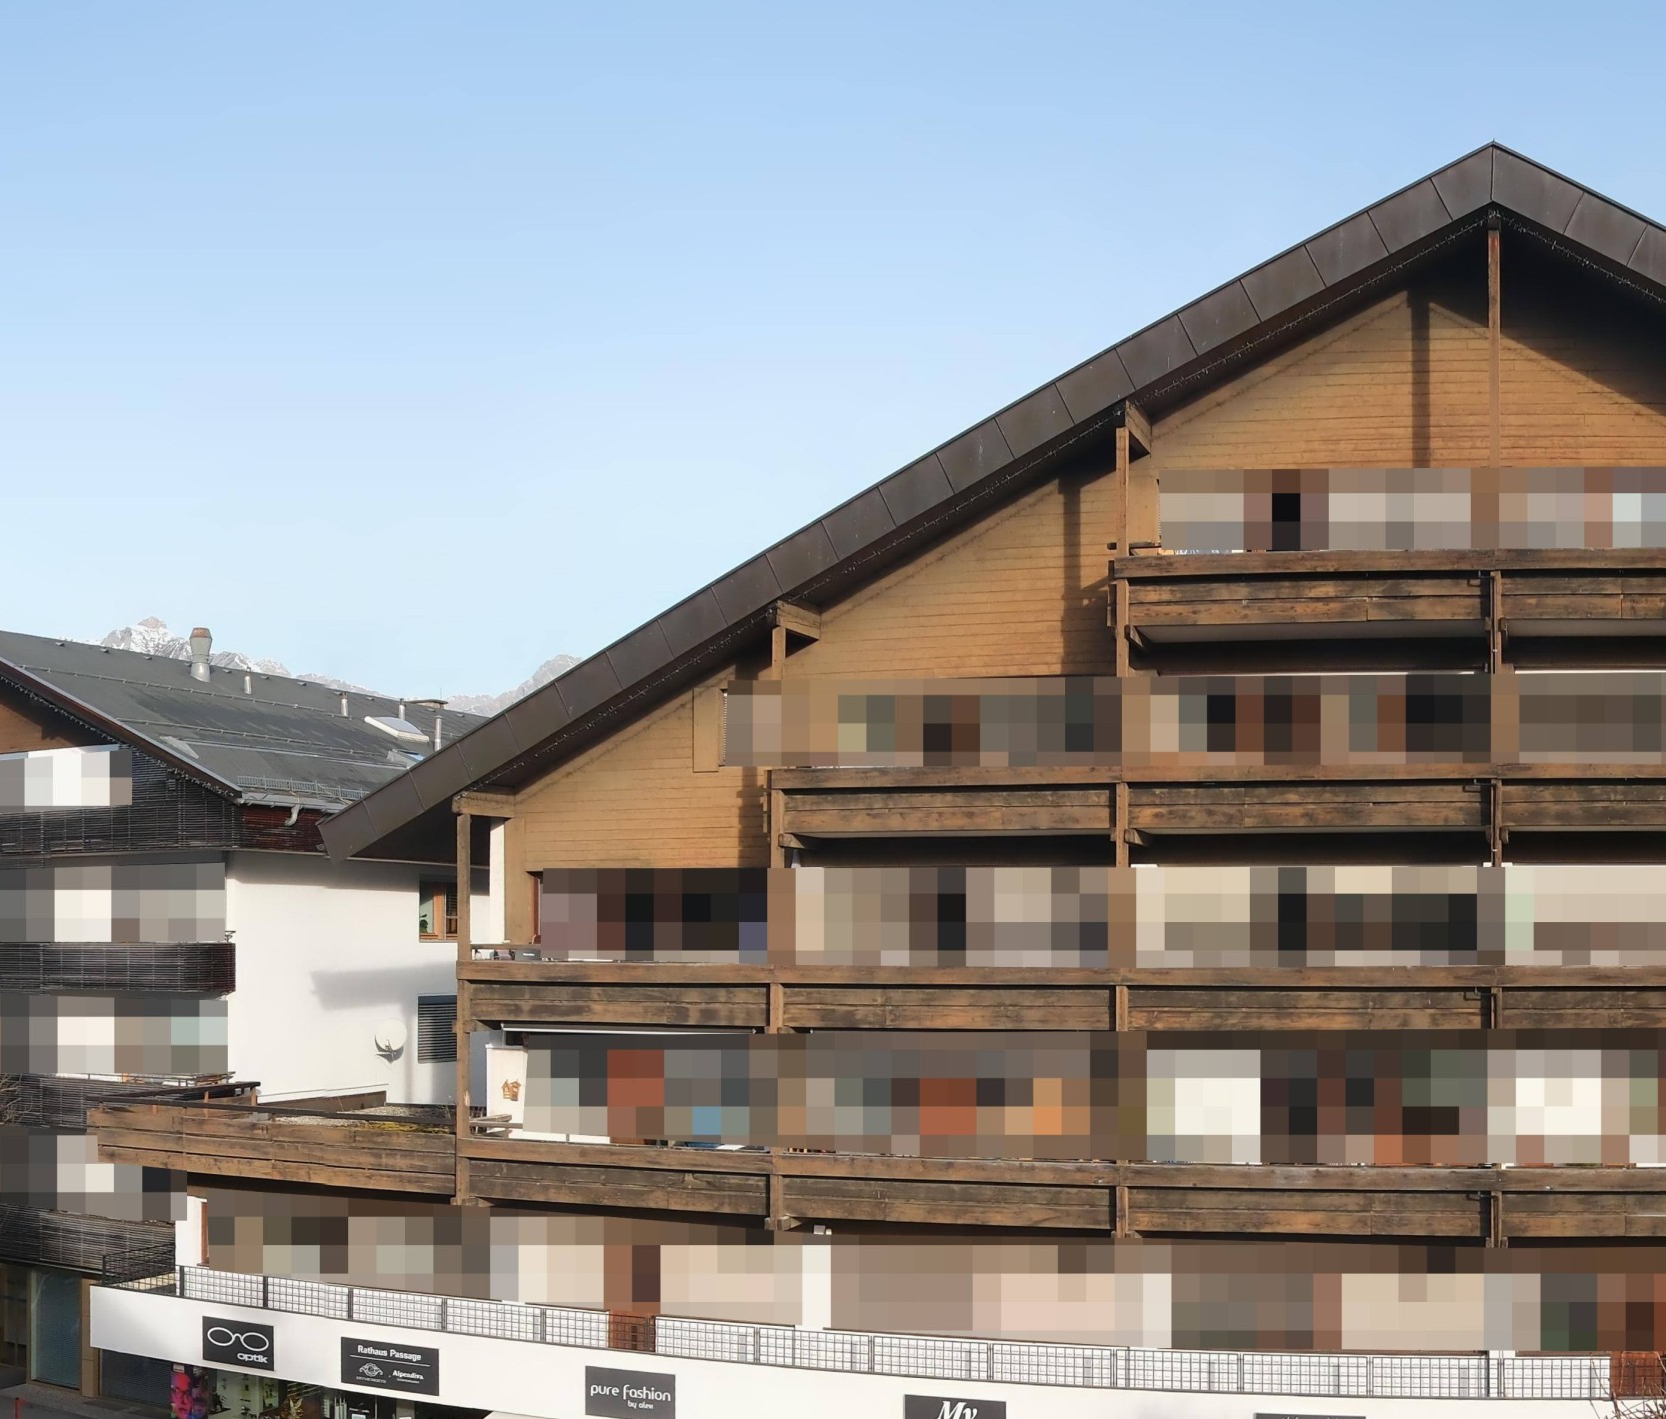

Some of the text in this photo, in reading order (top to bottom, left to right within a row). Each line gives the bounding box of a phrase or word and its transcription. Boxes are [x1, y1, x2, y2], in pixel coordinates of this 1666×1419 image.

[237, 1351, 268, 1364] optik
[357, 1345, 422, 1362] Rathaus Passage
[392, 1369, 424, 1380] Alpendiva
[590, 1384, 671, 1402] pure fashion
[627, 1400, 654, 1410] by alex
